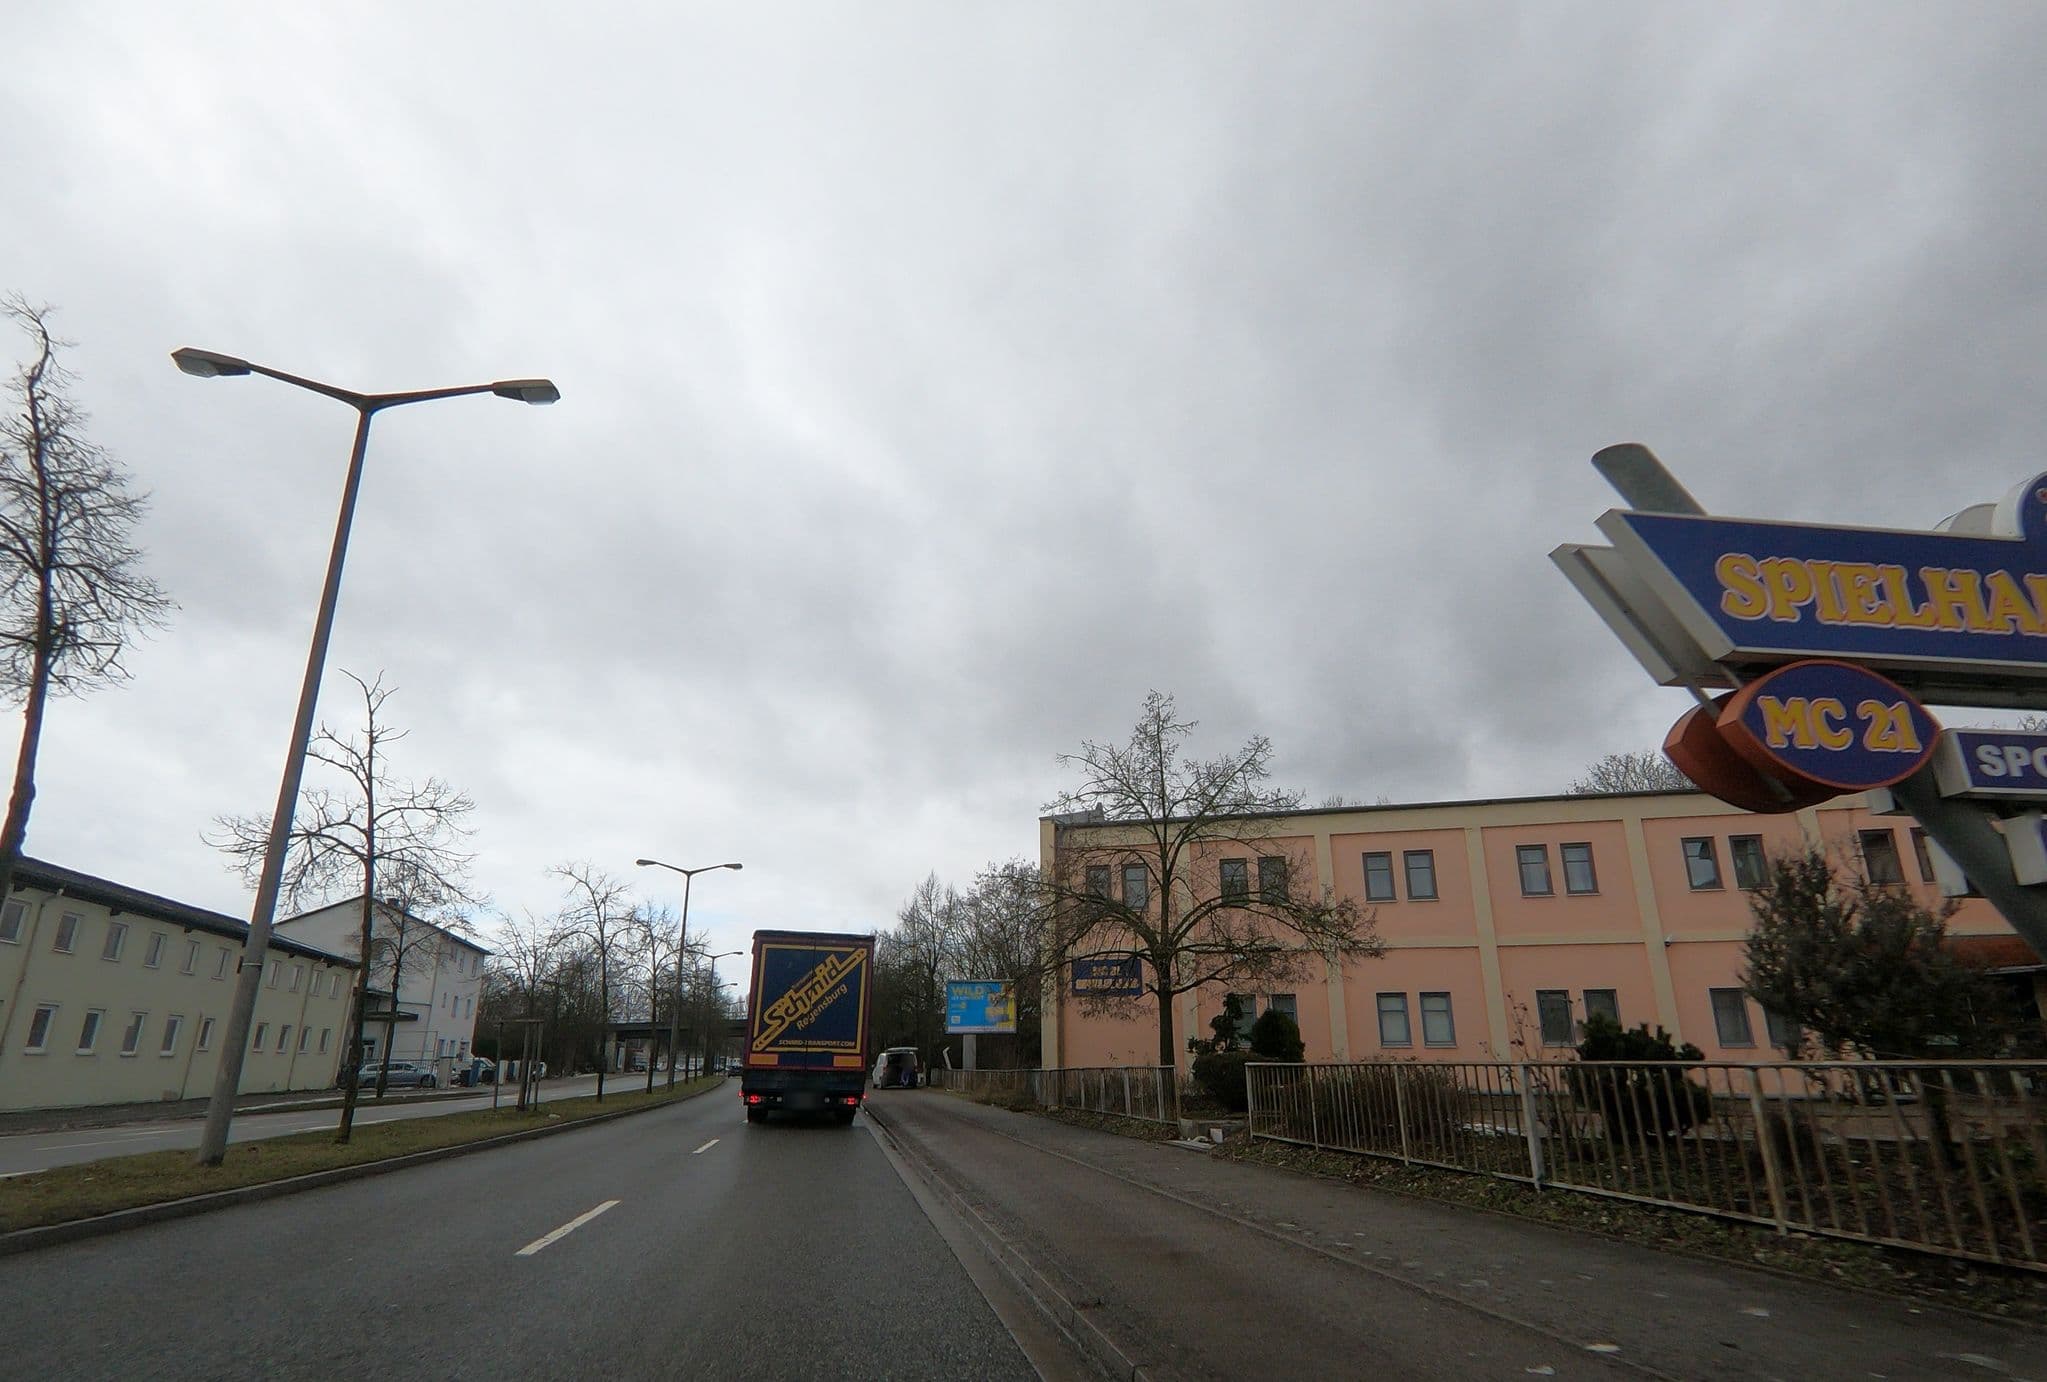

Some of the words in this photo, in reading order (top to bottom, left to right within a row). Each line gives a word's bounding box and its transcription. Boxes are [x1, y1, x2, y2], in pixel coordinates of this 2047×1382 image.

[1715, 553, 2047, 637] SPIELHA
[1757, 696, 1853, 751] MC
[1855, 700, 1922, 754] 21
[796, 983, 848, 1031] Regensburg
